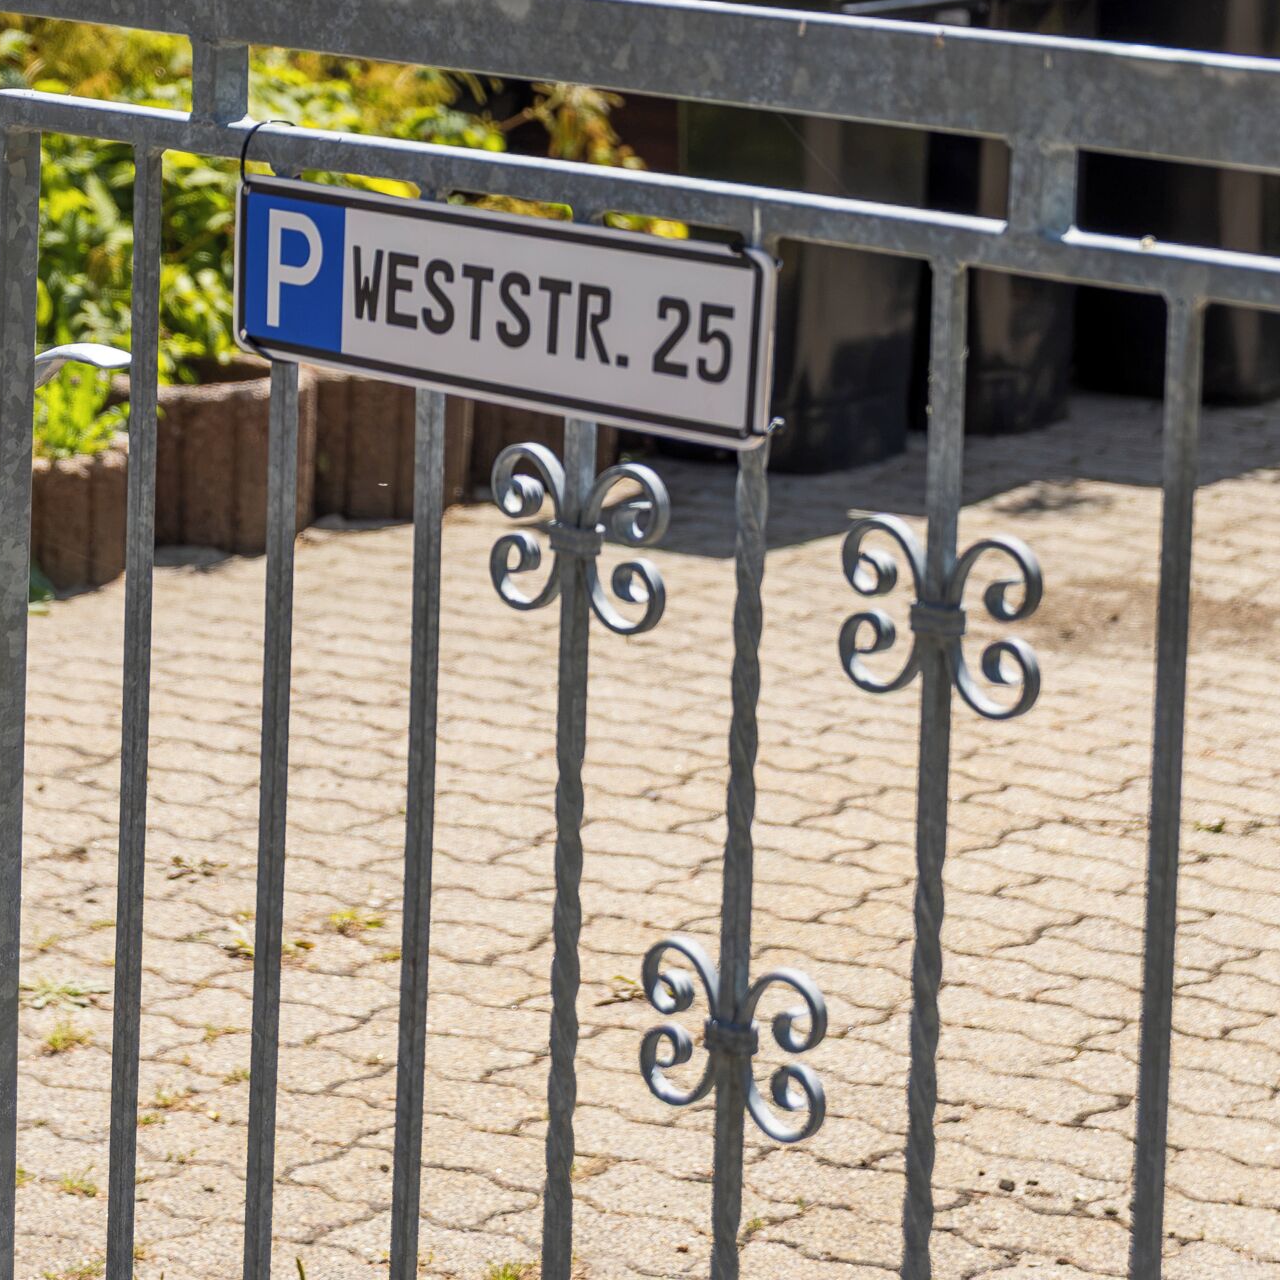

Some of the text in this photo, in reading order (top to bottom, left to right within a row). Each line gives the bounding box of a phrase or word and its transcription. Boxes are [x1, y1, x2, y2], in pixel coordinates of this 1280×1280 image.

[266, 208, 323, 328] P
[352, 244, 736, 384] WESTSTR. 25
